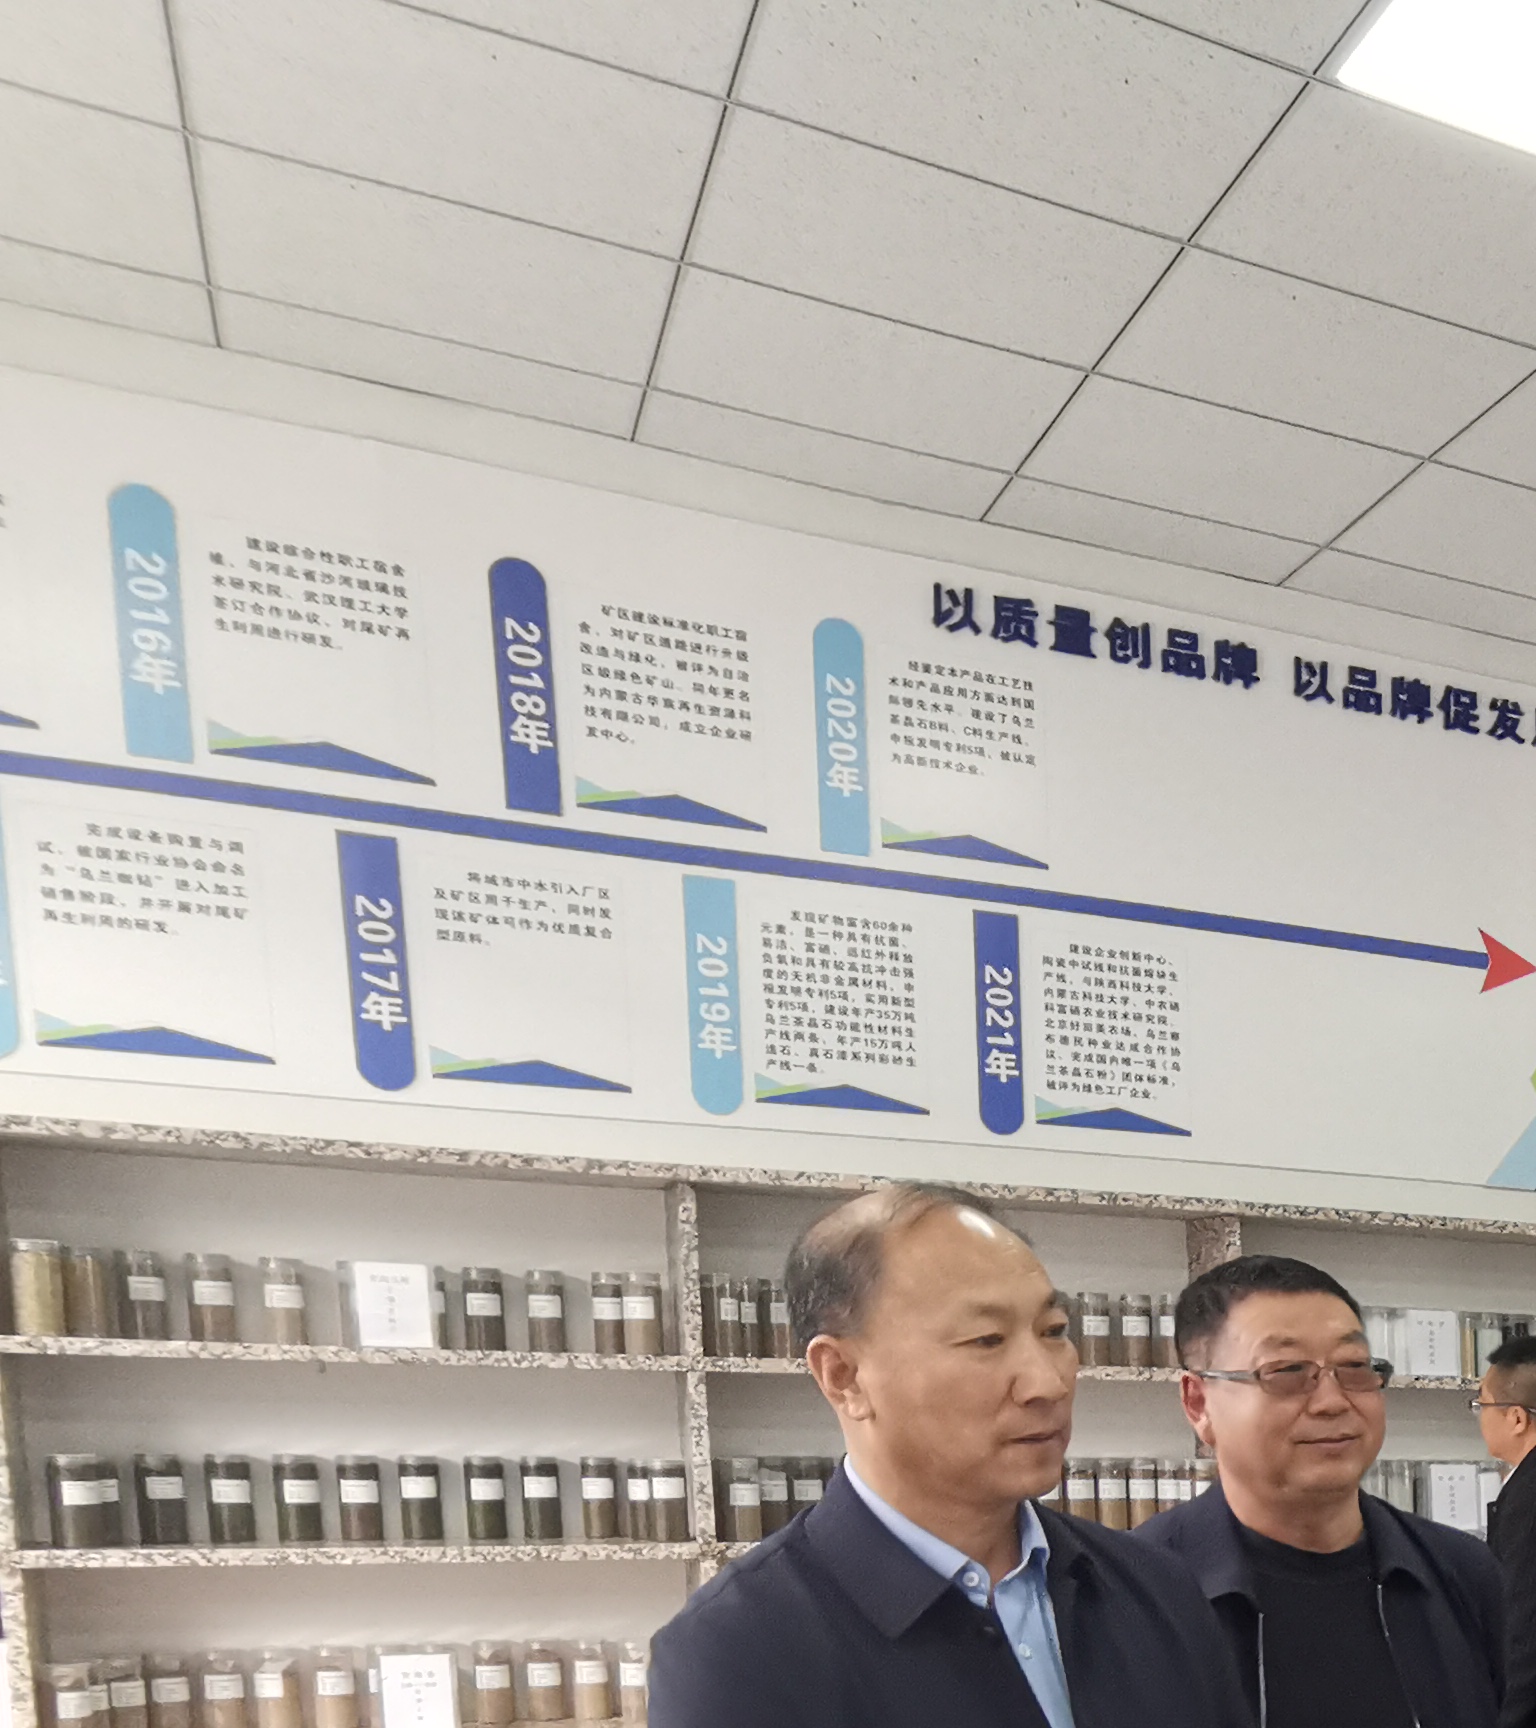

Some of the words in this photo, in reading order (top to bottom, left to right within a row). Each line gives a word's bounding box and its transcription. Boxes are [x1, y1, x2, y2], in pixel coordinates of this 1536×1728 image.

[121, 546, 183, 695] 2016年
[601, 604, 747, 641] 矿区建设标准化职工宿
[931, 582, 1260, 690] 以质量创品牌
[503, 621, 556, 755] 2018年
[824, 675, 865, 797] 2020年
[353, 894, 408, 1032] 2017年
[695, 932, 739, 1059] 2019年
[982, 965, 1020, 1083] 2021年
